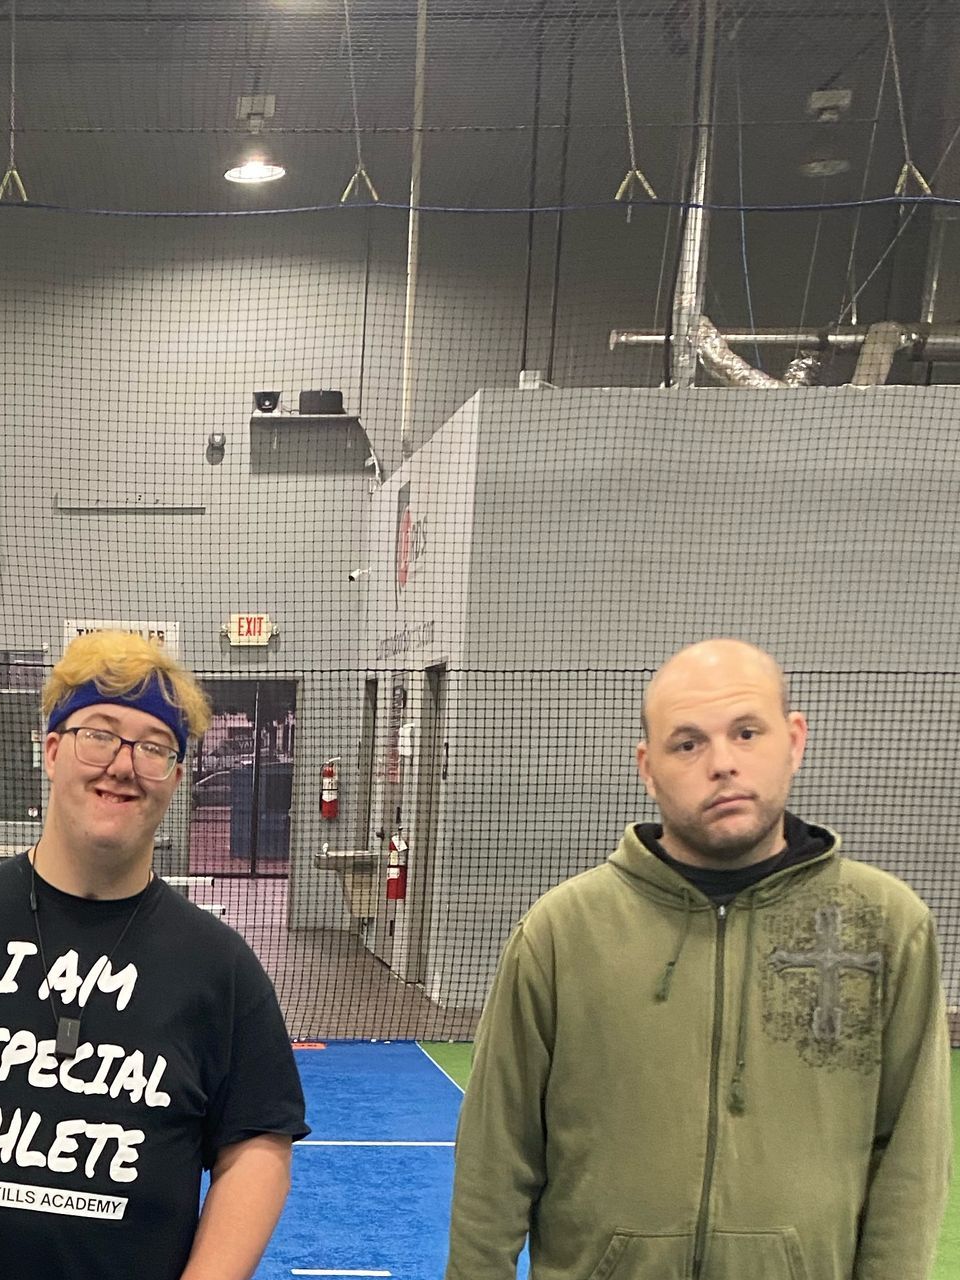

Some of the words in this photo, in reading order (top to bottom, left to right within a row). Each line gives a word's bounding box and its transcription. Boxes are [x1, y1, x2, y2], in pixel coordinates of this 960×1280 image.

[237, 616, 265, 637] EXIT
[37, 948, 138, 1012] AM
[40, 1193, 123, 1215] ACADEMY
